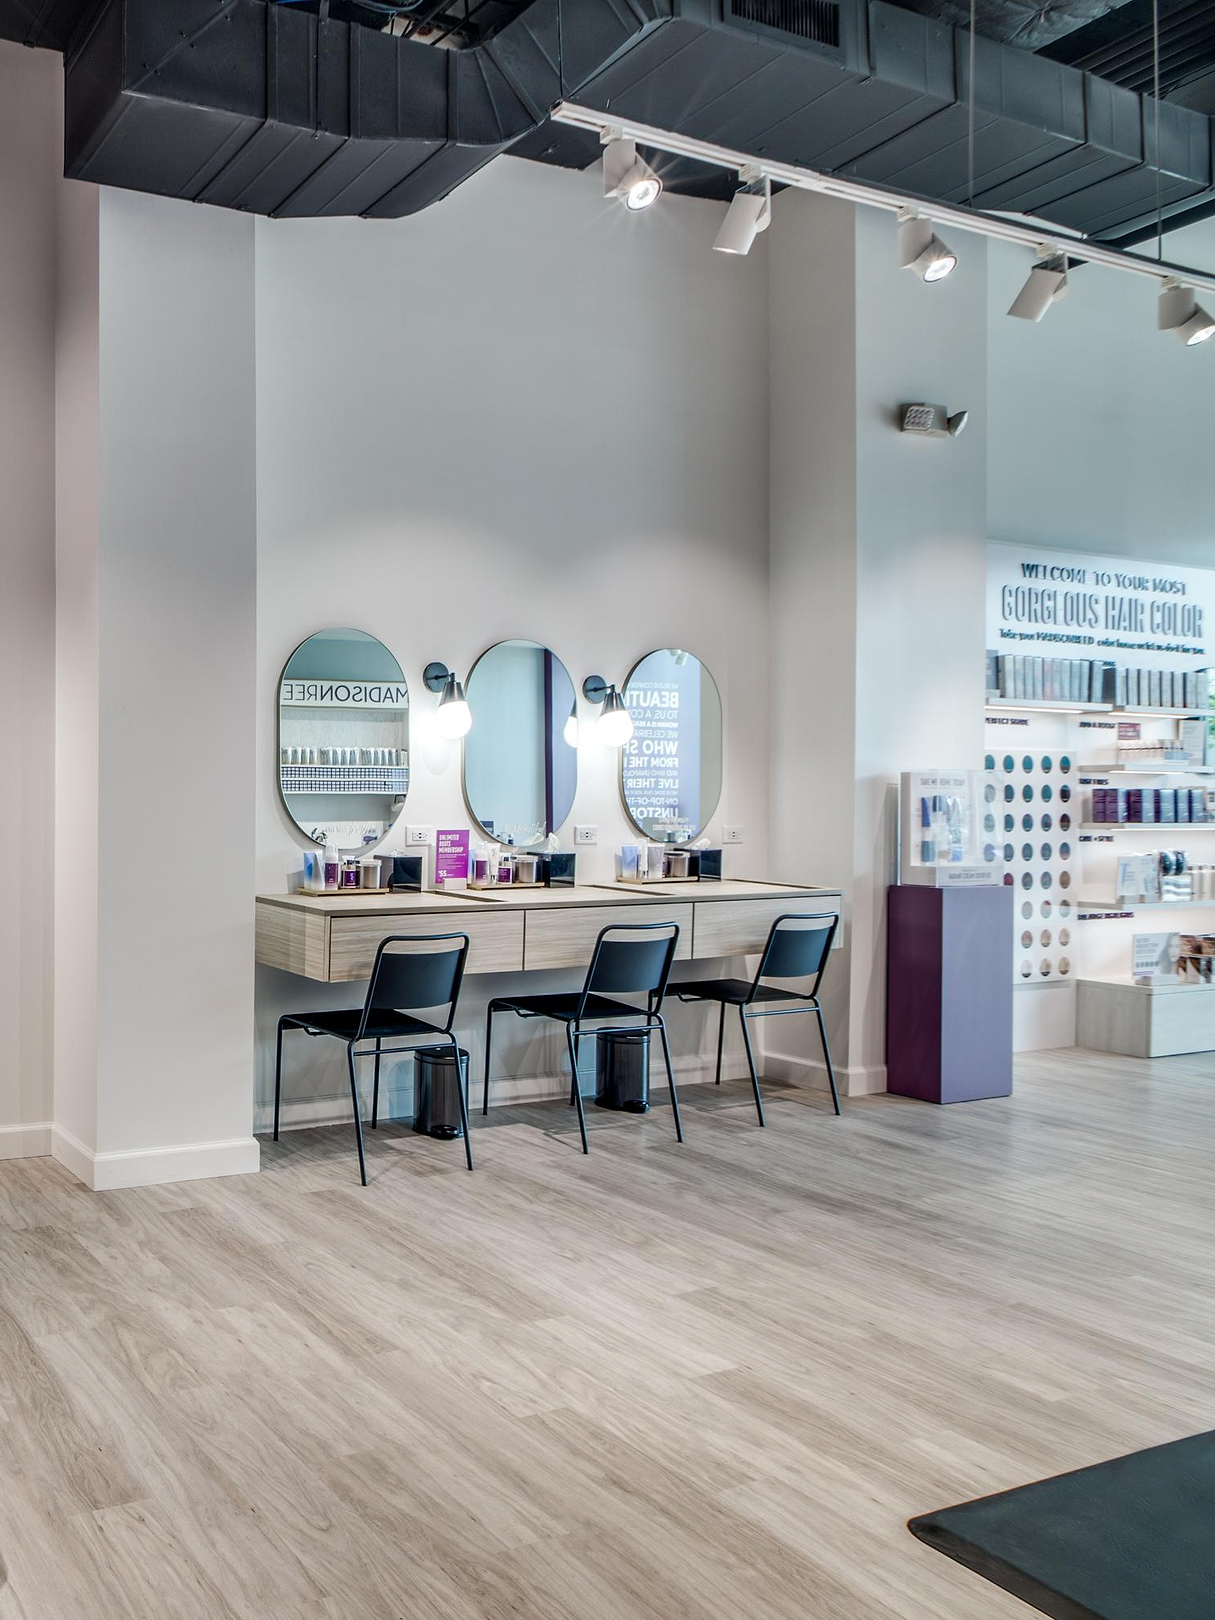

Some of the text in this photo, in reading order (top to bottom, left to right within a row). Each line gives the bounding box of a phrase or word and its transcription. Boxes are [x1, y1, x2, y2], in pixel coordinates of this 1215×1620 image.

[1020, 562, 1186, 596] WELCOME TO YOUR MOST
[1002, 584, 1203, 638] GORGEOUS HAIR COLOR
